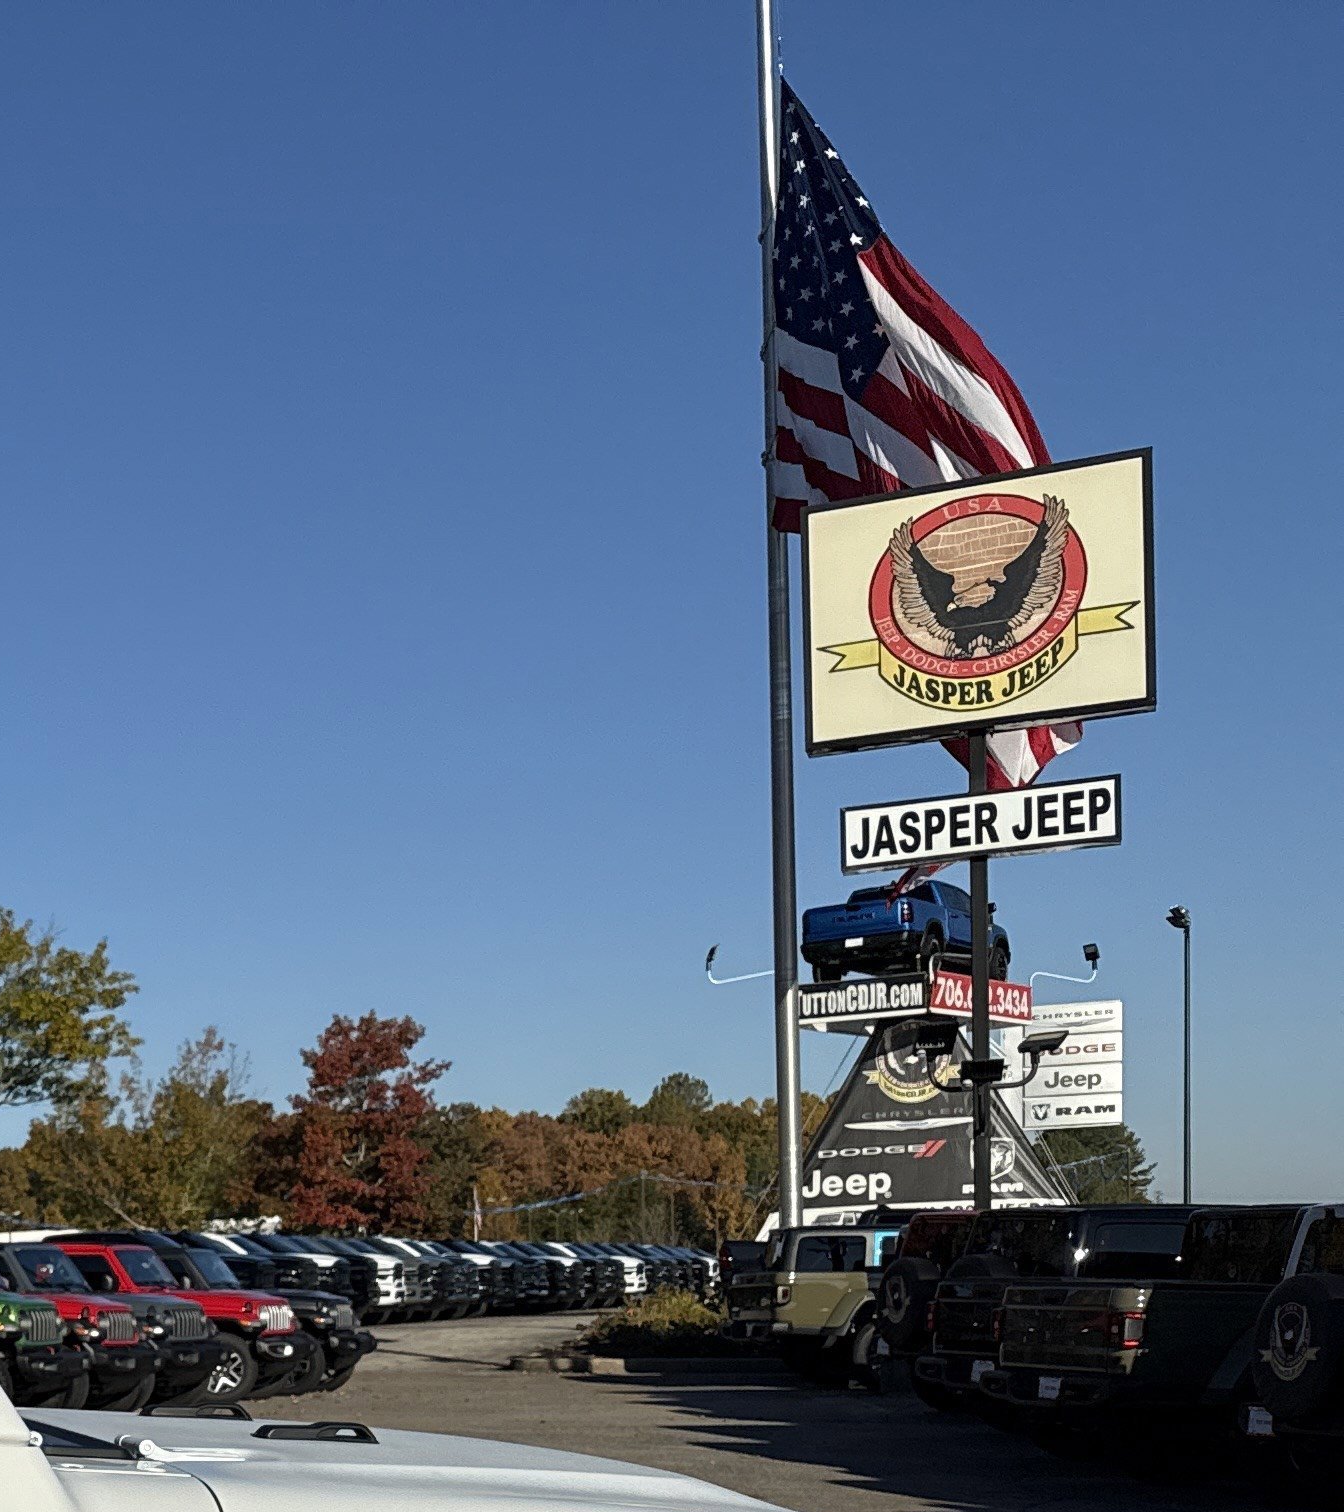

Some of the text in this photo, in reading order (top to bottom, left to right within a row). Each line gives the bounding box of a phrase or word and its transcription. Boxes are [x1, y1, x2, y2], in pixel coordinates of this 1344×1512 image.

[942, 497, 1003, 519] USA
[875, 589, 1080, 675] JEEP DODGE CHRYSLER RAM
[893, 637, 1064, 705] JASPER JEEP
[850, 787, 1112, 860] JASPER JEEP
[934, 976, 1029, 1017] 706..3434
[1032, 1009, 1114, 1020] CHRYSLER
[1040, 1043, 1116, 1056] ODGE
[1044, 1071, 1102, 1090] Jeep
[862, 1107, 965, 1120] CHRYSLER
[1055, 1104, 1116, 1116] RAM
[818, 1144, 926, 1159] DODGE
[802, 1169, 892, 1201] Jeep
